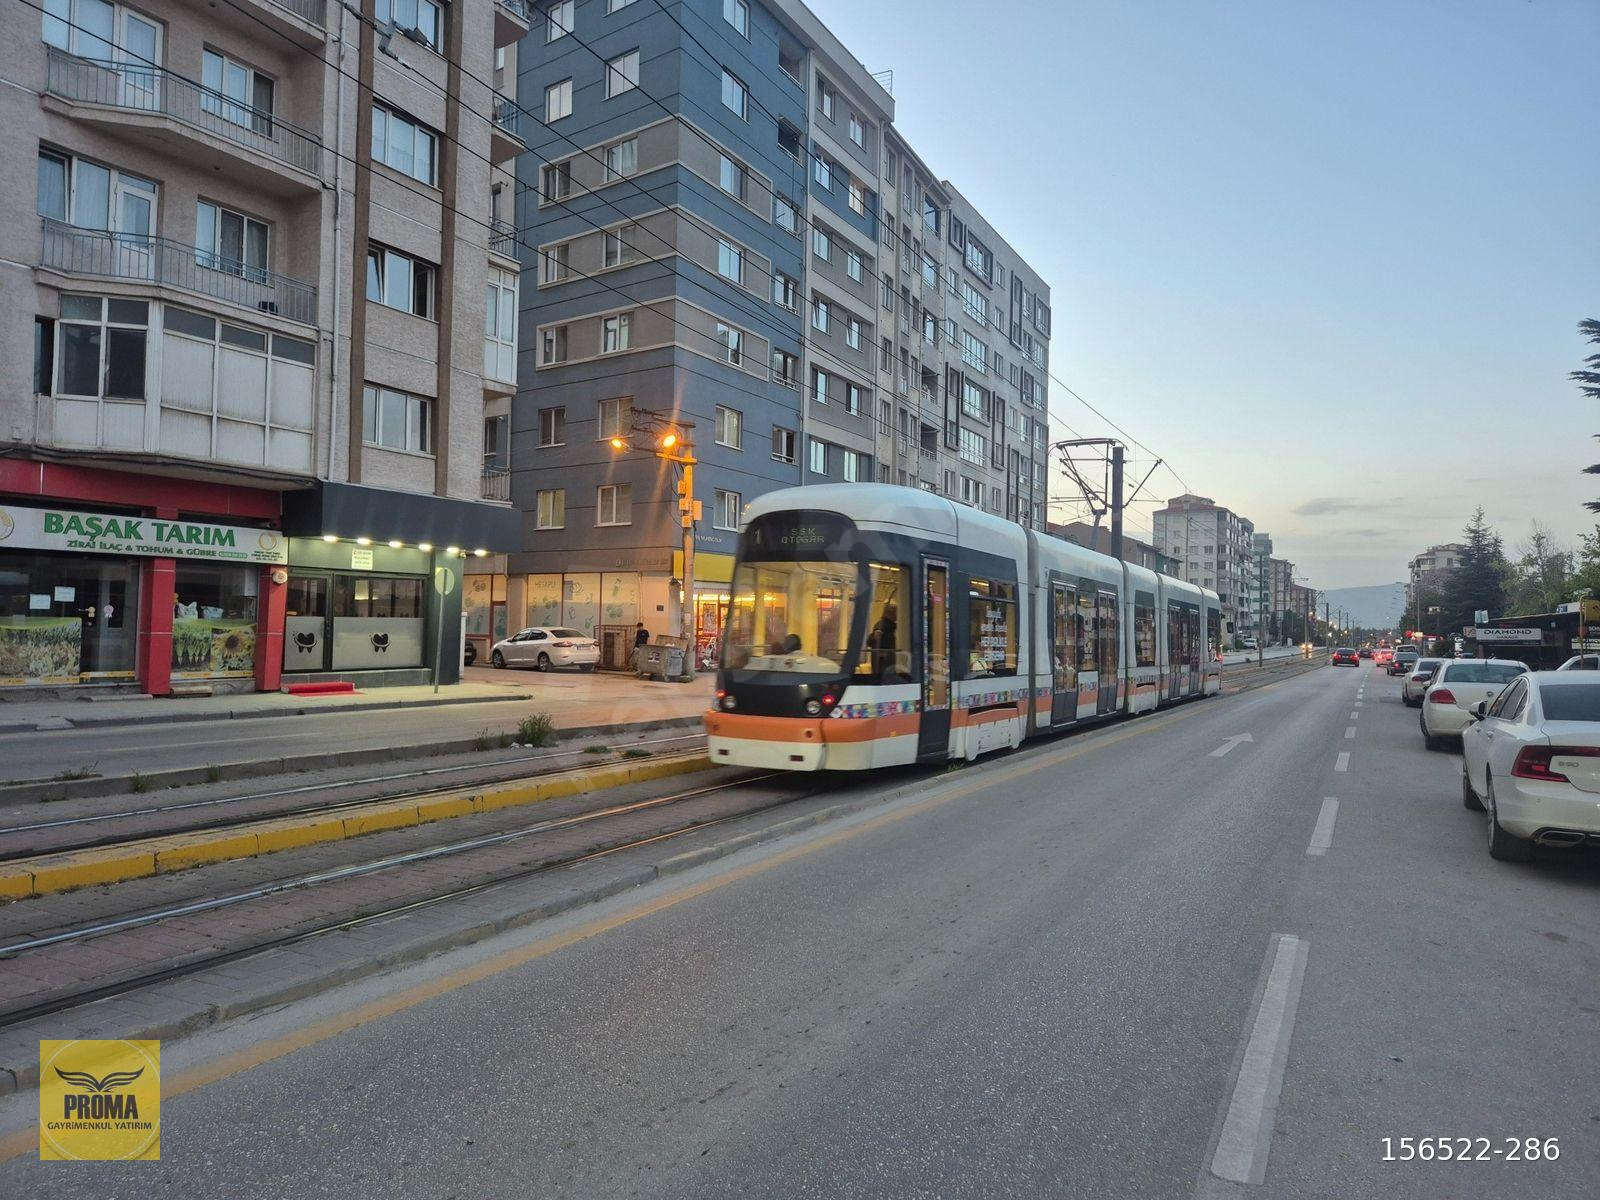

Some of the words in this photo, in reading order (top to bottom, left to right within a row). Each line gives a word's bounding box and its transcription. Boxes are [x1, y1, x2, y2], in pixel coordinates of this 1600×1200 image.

[44, 511, 143, 542] BAŞAK
[152, 521, 236, 547] TARIM
[136, 545, 174, 554] TOHUM
[186, 547, 217, 557] GÜBRE
